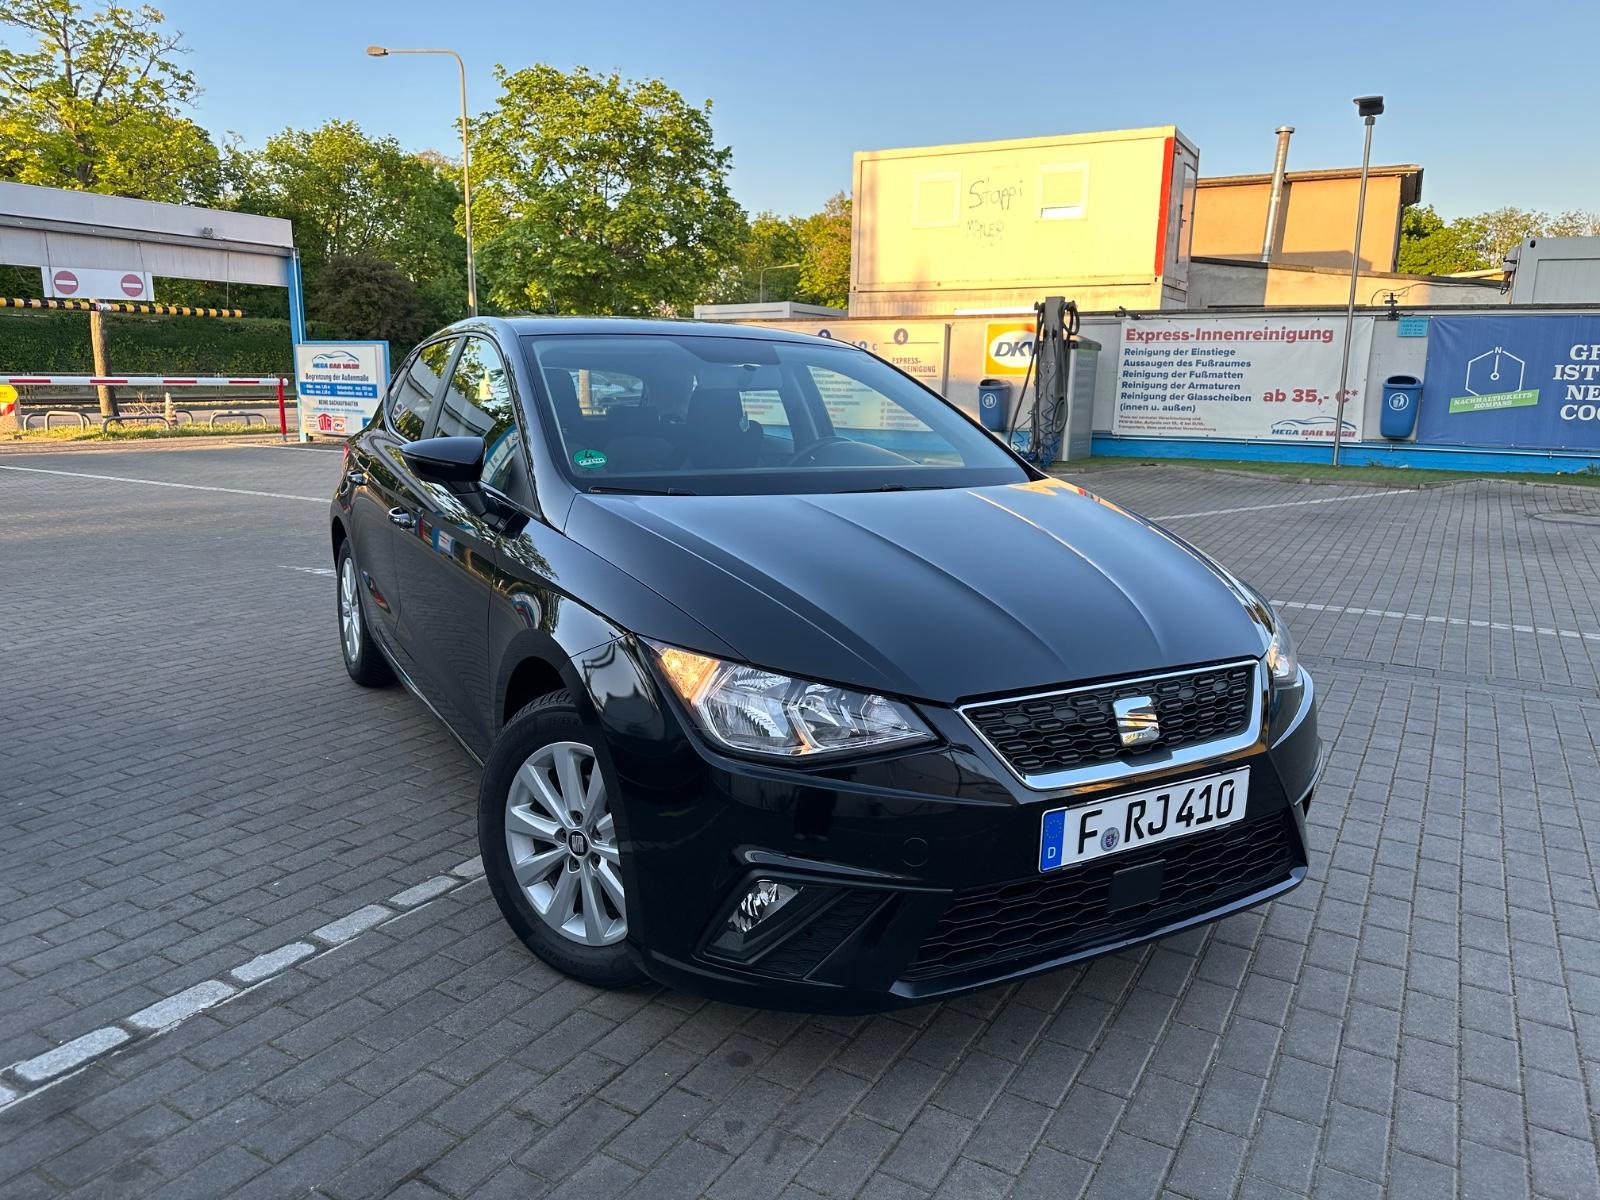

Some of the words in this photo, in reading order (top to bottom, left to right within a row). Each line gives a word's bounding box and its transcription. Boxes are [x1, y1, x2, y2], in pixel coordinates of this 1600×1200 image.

[1125, 327, 1334, 344] Express-Innenreinigung
[1124, 347, 1171, 358] Reinigung
[1173, 347, 1188, 356] der
[1191, 348, 1236, 358] Einstiege
[1494, 346, 1502, 354] N
[1123, 359, 1174, 369] Aussaugen
[1176, 359, 1193, 368] des
[1195, 359, 1252, 368] Fußraumes
[1122, 370, 1169, 380] Reinigung
[1171, 370, 1187, 379] der
[1189, 370, 1244, 379] Fußmatten
[1552, 364, 1600, 381] IST
[1121, 380, 1168, 391] Reinigung
[1170, 381, 1186, 390] der
[1188, 381, 1241, 391] Armaturen
[1120, 391, 1167, 402] Reinigung
[1169, 392, 1185, 401] der
[1187, 392, 1252, 402] Glasscheiben
[1263, 388, 1286, 403] ab
[1291, 388, 1330, 406] 35,-
[1119, 403, 1149, 412] (innen
[1151, 404, 1160, 412] u.
[1162, 403, 1197, 413] außen)
[1560, 404, 1600, 421] CO
[1325, 430, 1356, 438] WSH
[1077, 809, 1103, 854] F
[1047, 846, 1056, 859] D
